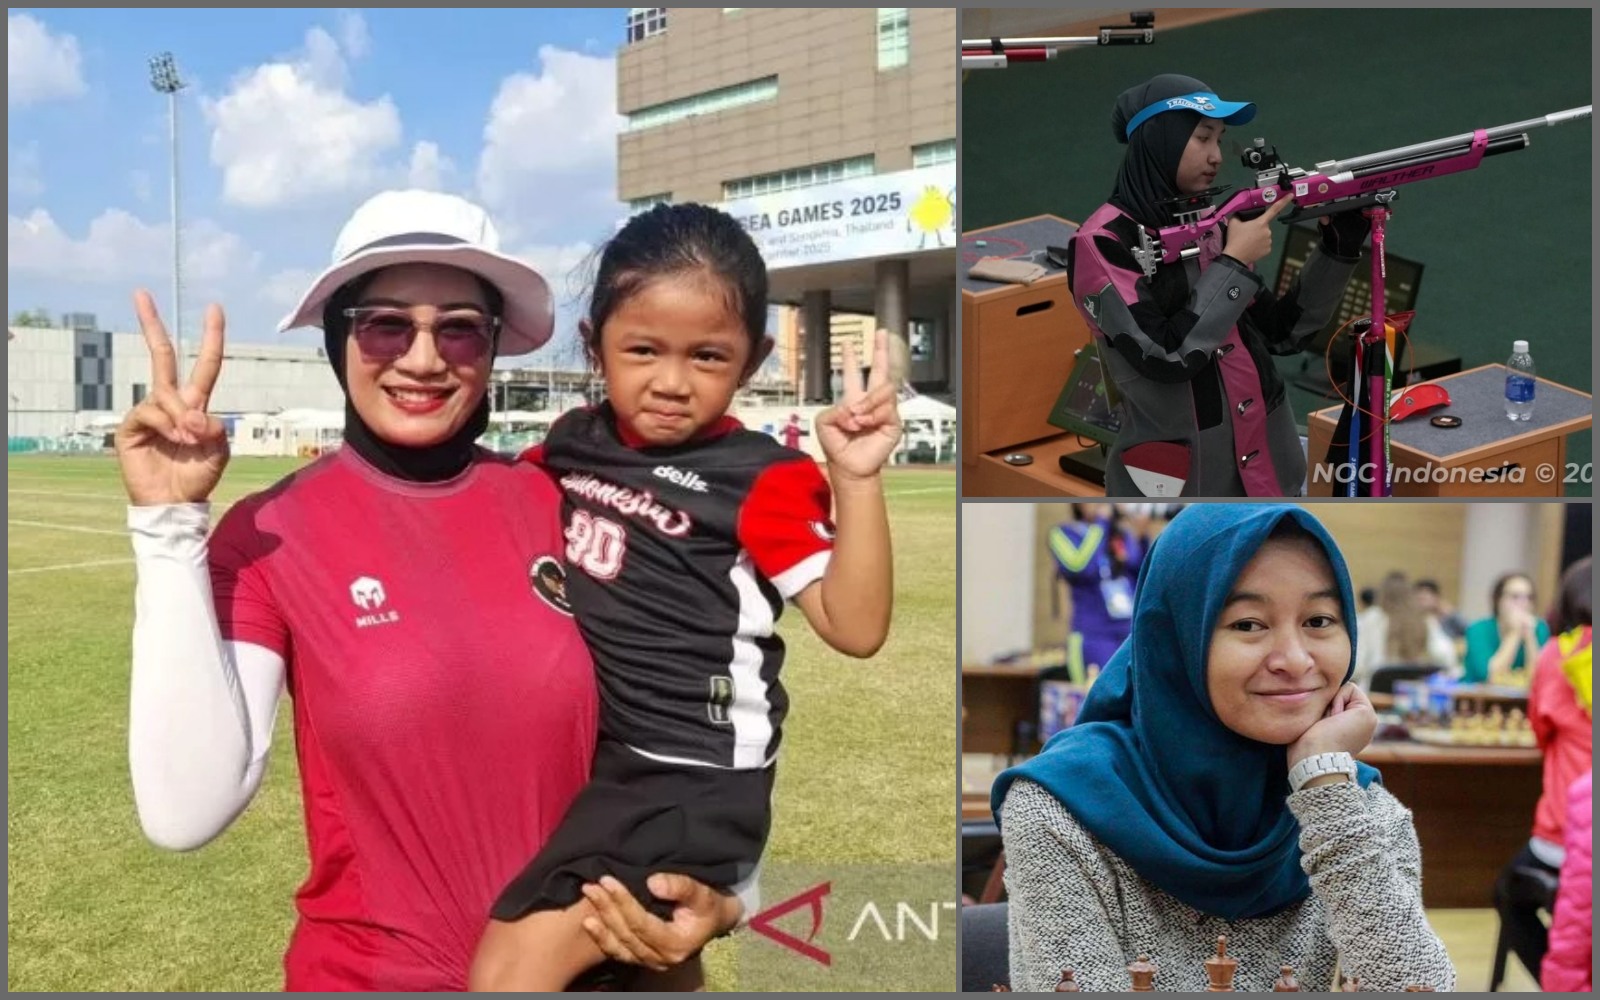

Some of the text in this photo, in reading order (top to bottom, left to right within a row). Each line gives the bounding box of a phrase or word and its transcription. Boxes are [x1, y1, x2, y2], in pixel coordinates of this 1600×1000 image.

[1360, 165, 1435, 190] WALTHER
[778, 201, 844, 227] GAMES
[850, 191, 902, 217] 2025
[846, 219, 894, 237] Thailand
[355, 610, 400, 628] MILLS
